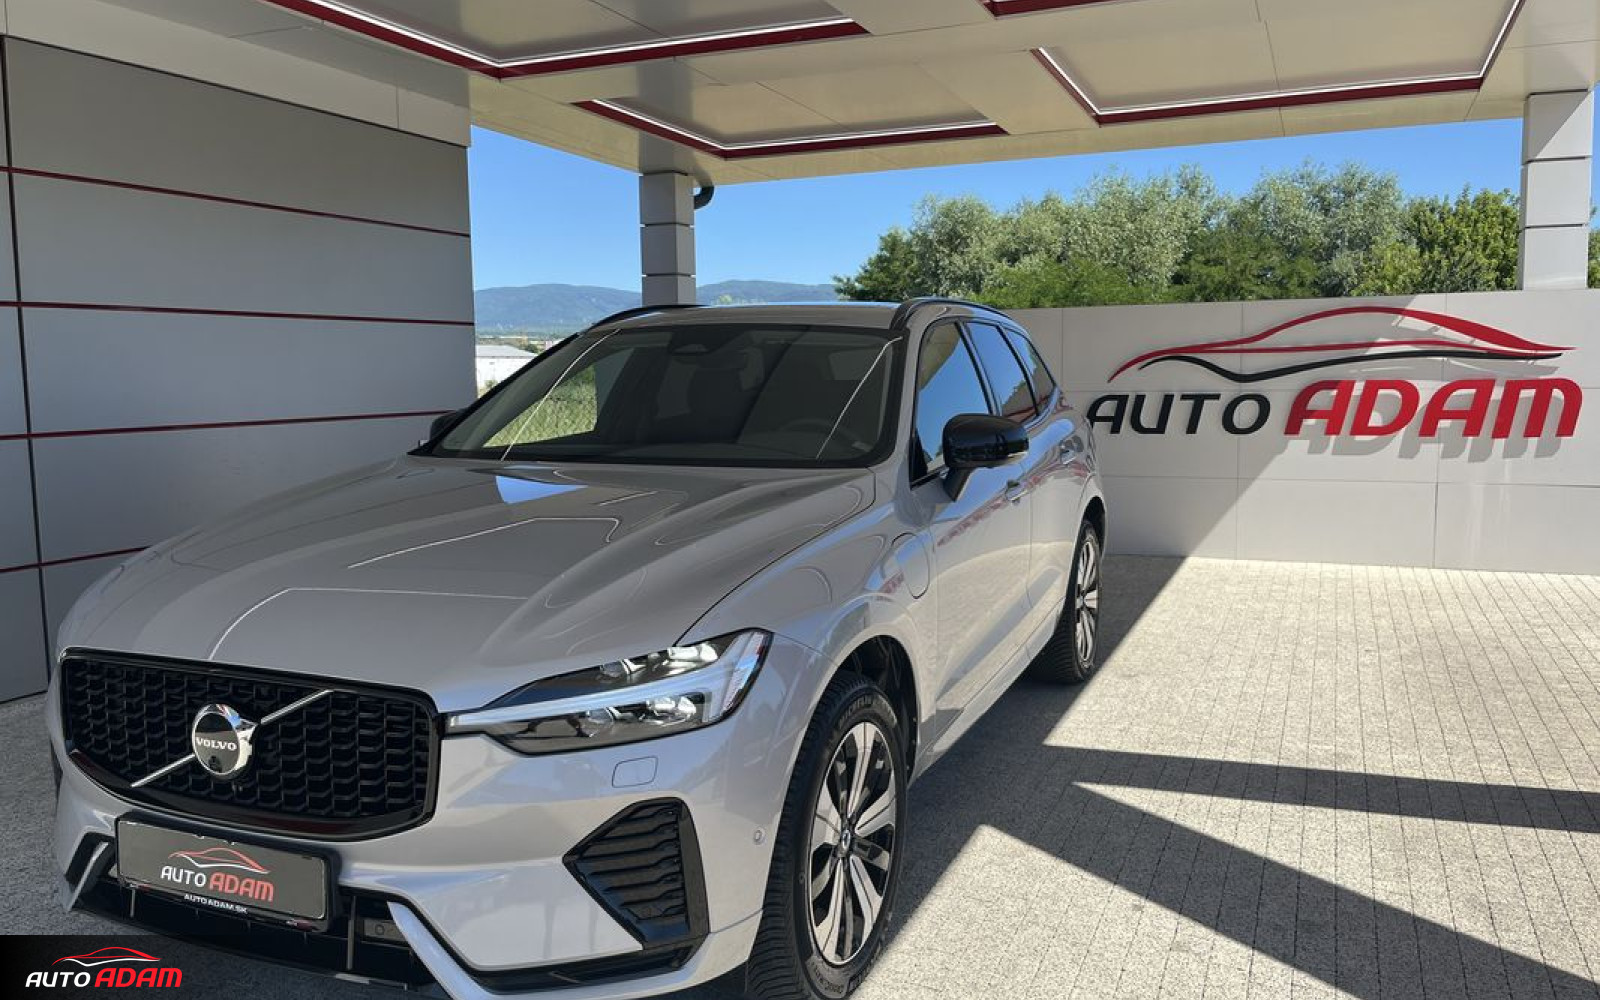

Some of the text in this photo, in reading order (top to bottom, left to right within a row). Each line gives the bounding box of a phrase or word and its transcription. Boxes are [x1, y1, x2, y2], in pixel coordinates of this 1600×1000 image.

[1088, 378, 1583, 439] AUTO ADAM
[195, 736, 237, 751] VOLVO
[161, 865, 274, 902] AUTO ADAM
